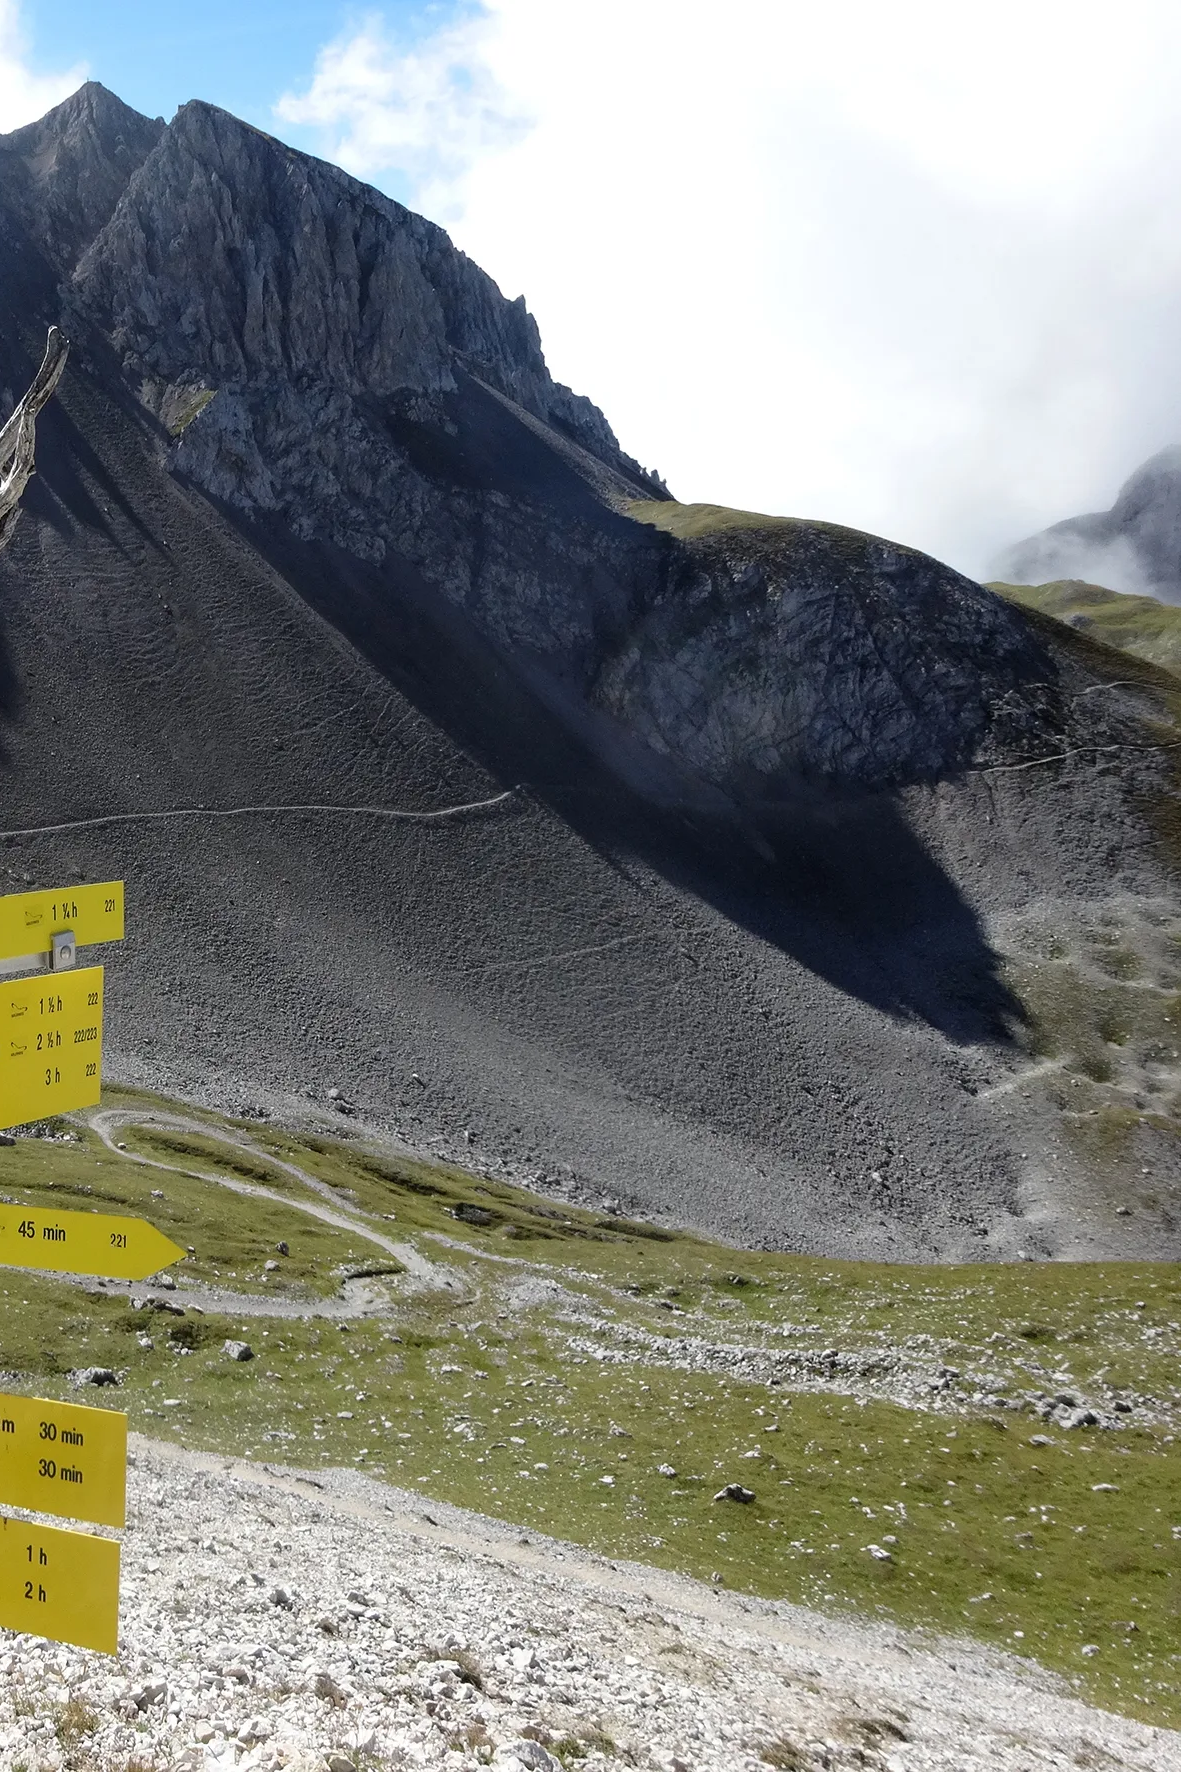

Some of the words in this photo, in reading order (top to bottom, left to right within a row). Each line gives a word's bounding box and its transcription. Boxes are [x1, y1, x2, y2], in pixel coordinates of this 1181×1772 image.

[52, 904, 57, 921] 1
[71, 901, 78, 918] h
[104, 899, 116, 913] 221
[39, 998, 44, 1015] 1
[57, 995, 62, 1012] h
[87, 992, 99, 1006] 222
[36, 1033, 43, 1051] 2
[55, 1030, 61, 1047] h
[73, 1026, 98, 1044] 222/223
[45, 1068, 52, 1086] 3
[55, 1067, 61, 1083] h
[85, 1062, 97, 1077] 222
[18, 1220, 36, 1239] 45
[43, 1225, 66, 1243] min
[110, 1233, 128, 1249] 221
[39, 1421, 57, 1442] 30
[61, 1427, 84, 1447] min
[38, 1458, 57, 1479] 30
[60, 1464, 83, 1484] min
[26, 1545, 34, 1563] 1
[39, 1547, 48, 1567] h
[24, 1582, 35, 1600] 2
[37, 1583, 47, 1603] h
